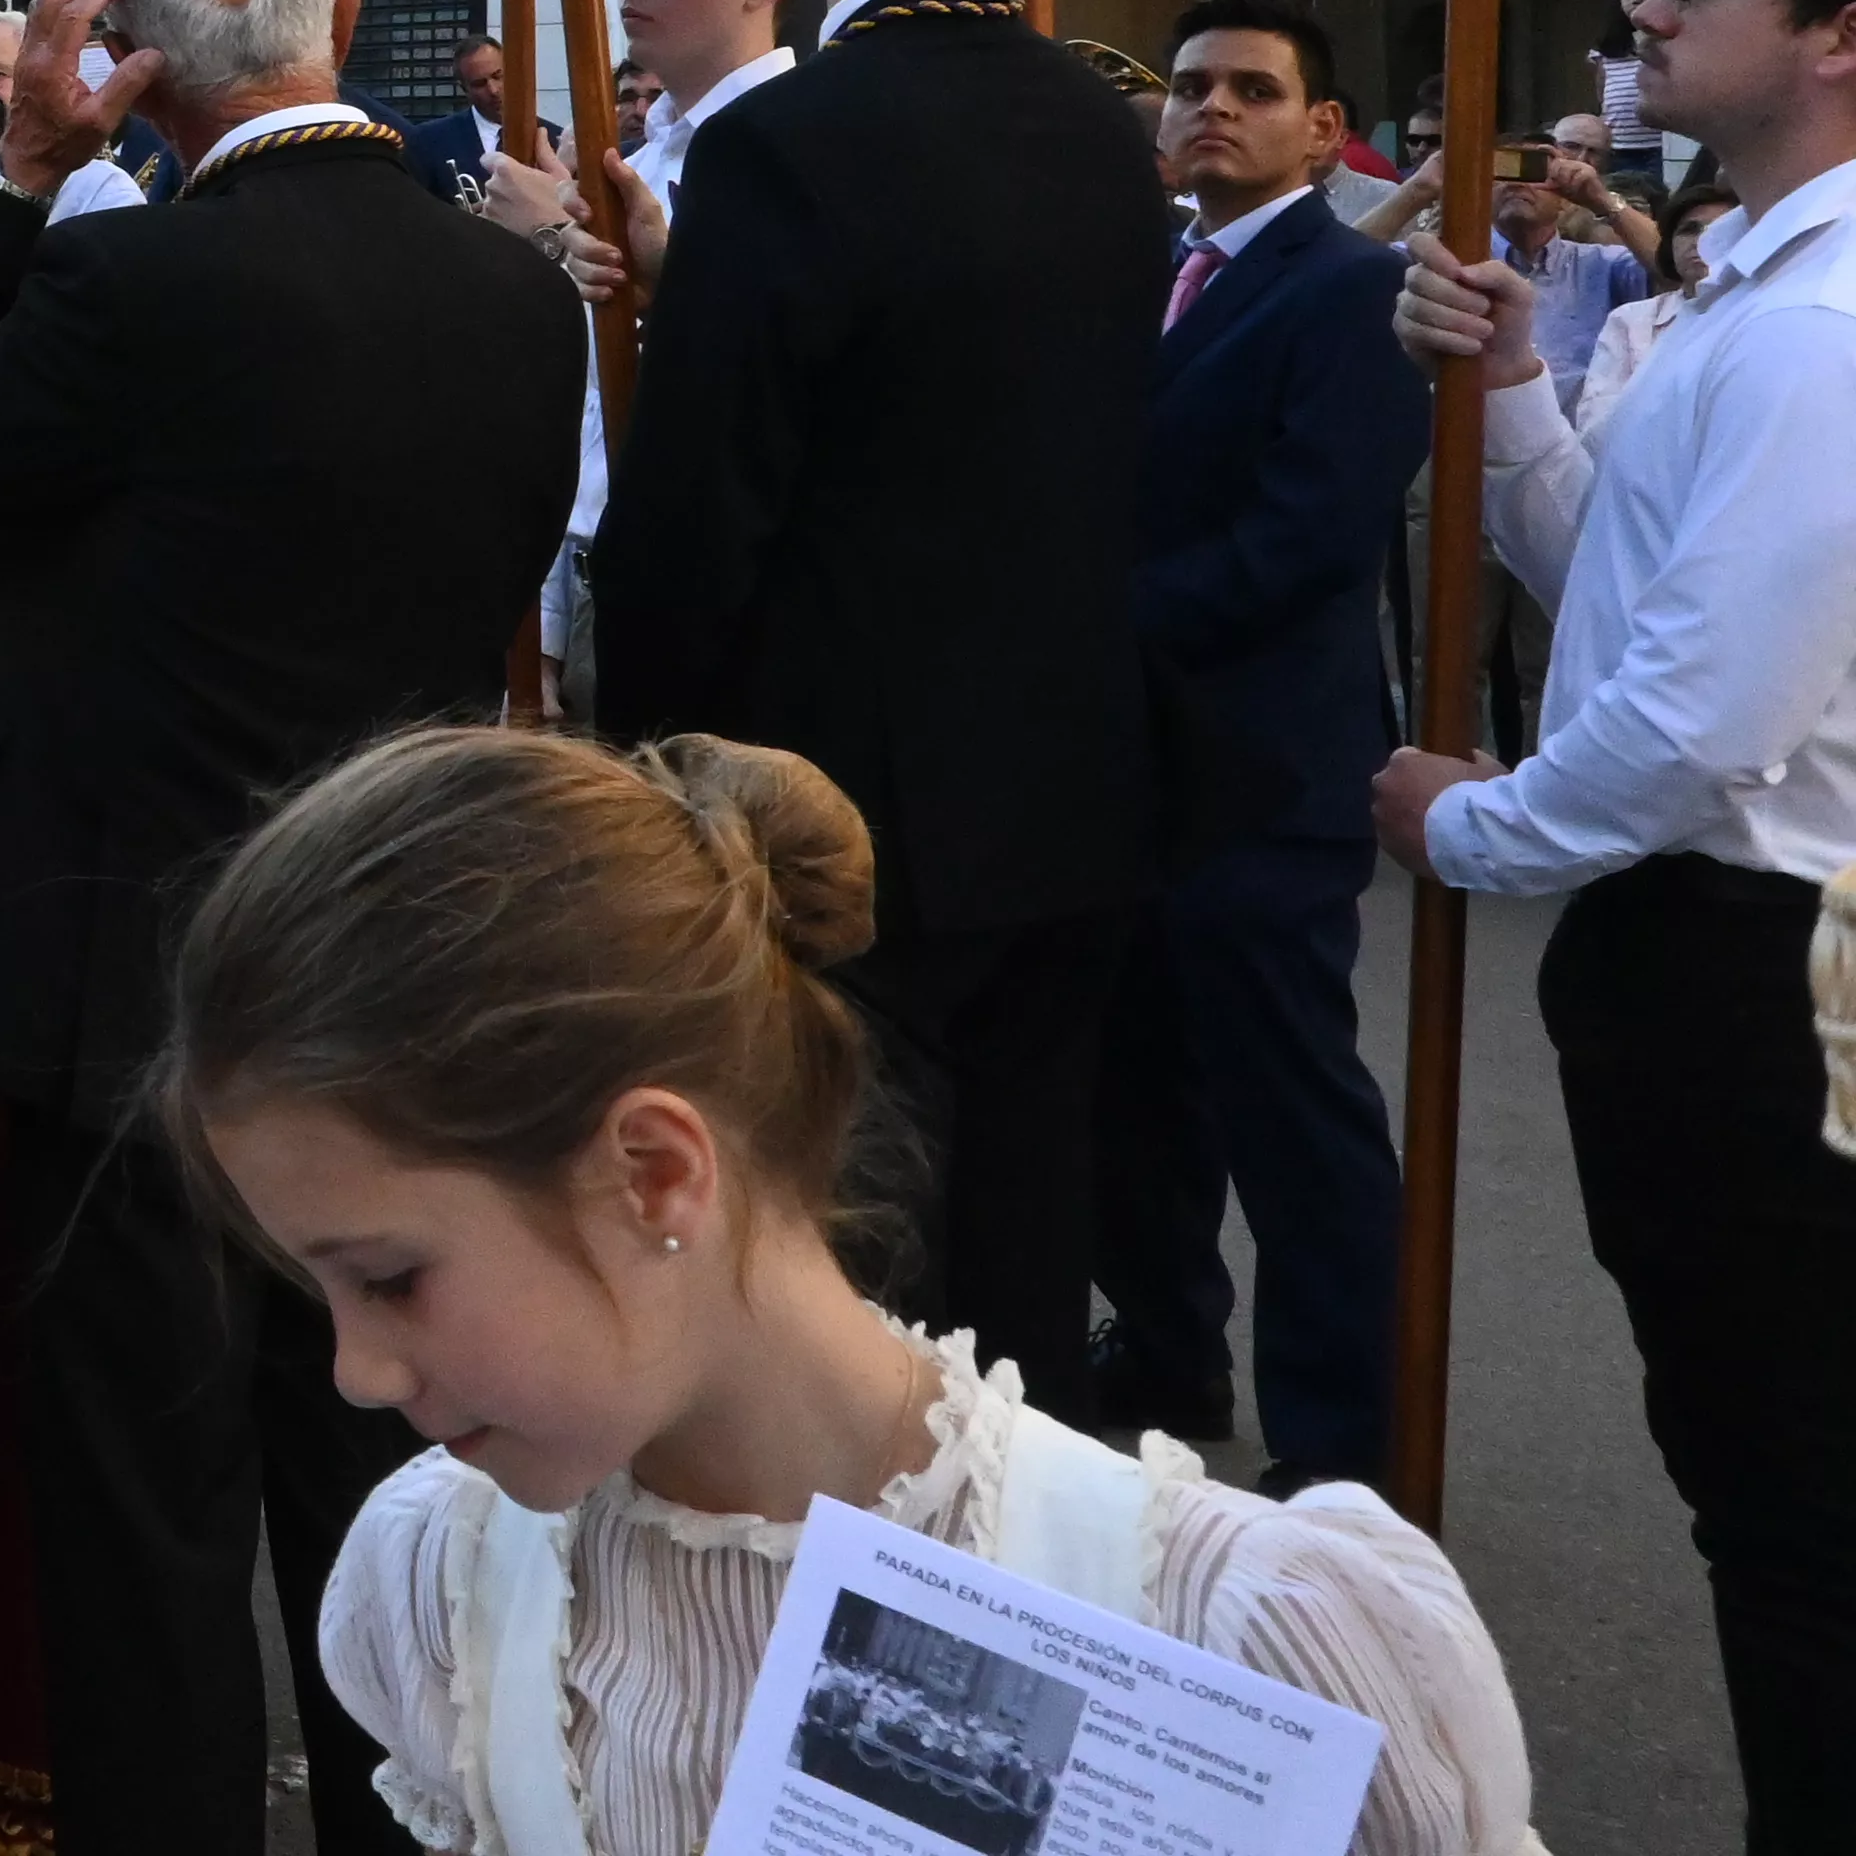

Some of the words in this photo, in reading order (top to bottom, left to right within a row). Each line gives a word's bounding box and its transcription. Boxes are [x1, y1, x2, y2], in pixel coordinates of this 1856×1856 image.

[875, 1550, 951, 1594] PARADA
[956, 1584, 984, 1606] EN
[988, 1597, 1012, 1620] LA
[1018, 1610, 1132, 1667] PROCESIÓN
[1136, 1659, 1175, 1687] DEL
[1180, 1677, 1263, 1723] CORPUS
[1268, 1713, 1315, 1744] CON
[1031, 1638, 1071, 1665] LOS
[1075, 1655, 1137, 1691] NIÑOS
[1082, 1722, 1130, 1748] amor
[1135, 1742, 1157, 1760] de
[1162, 1751, 1190, 1774] los
[1195, 1768, 1265, 1806] amores
[1155, 1726, 1248, 1776] Cantemos
[1253, 1769, 1272, 1785] al
